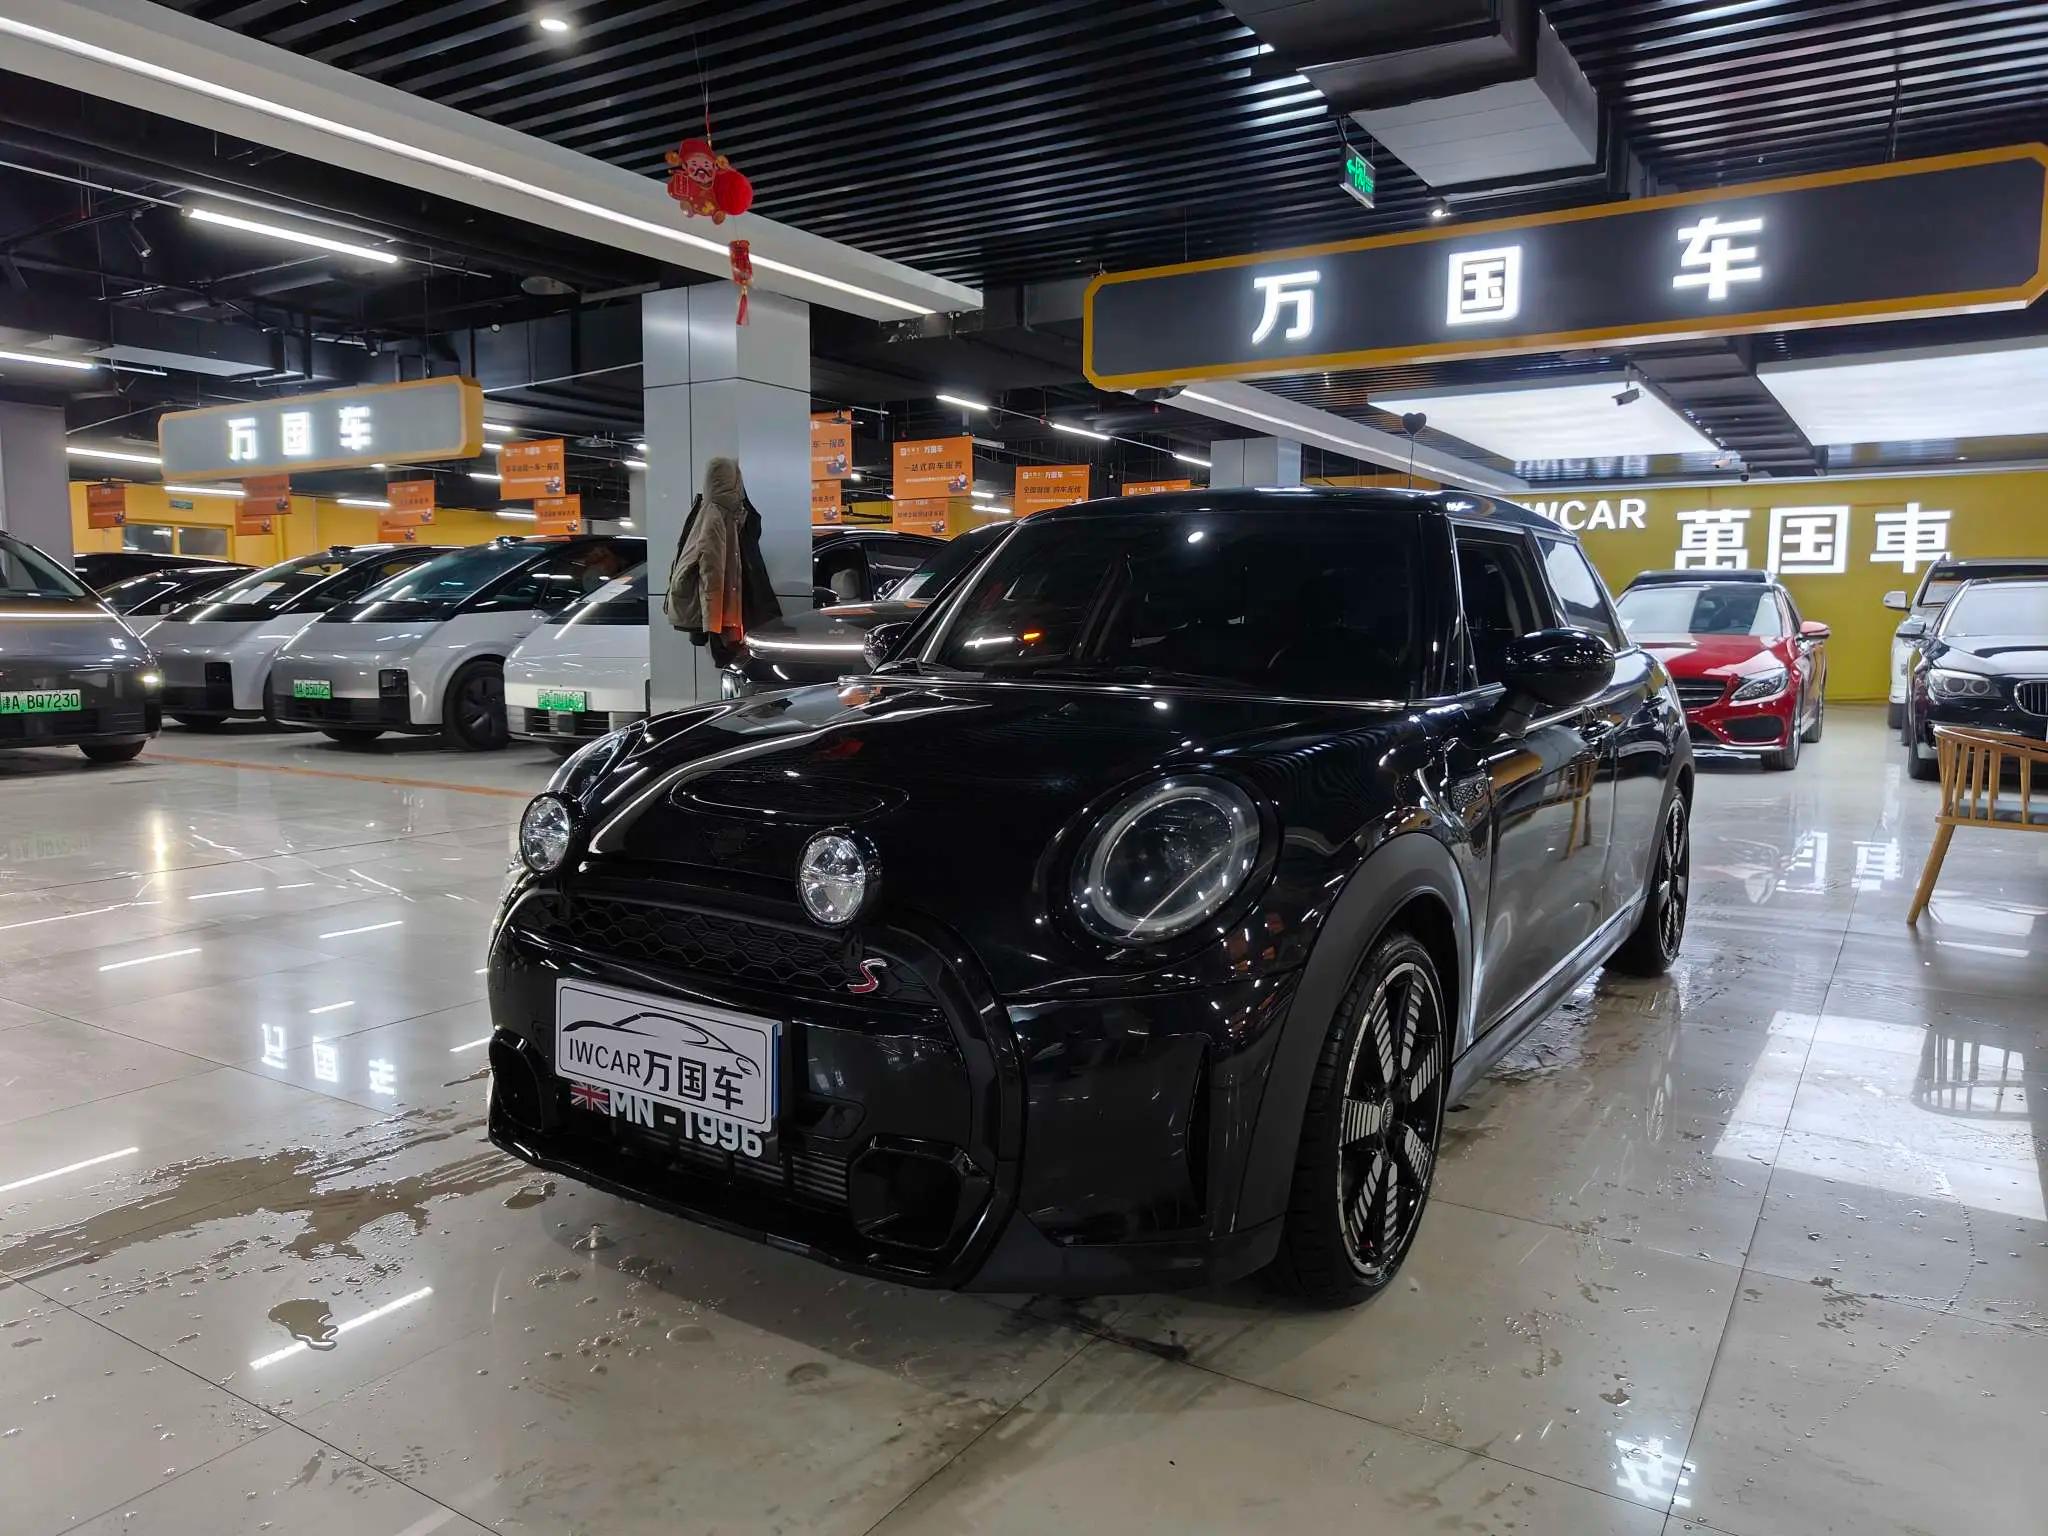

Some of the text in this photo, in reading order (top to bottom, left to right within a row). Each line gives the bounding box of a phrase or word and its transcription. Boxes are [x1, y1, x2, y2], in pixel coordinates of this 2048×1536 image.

[1251, 217, 1763, 344] 万国车
[228, 406, 372, 461] 万国车
